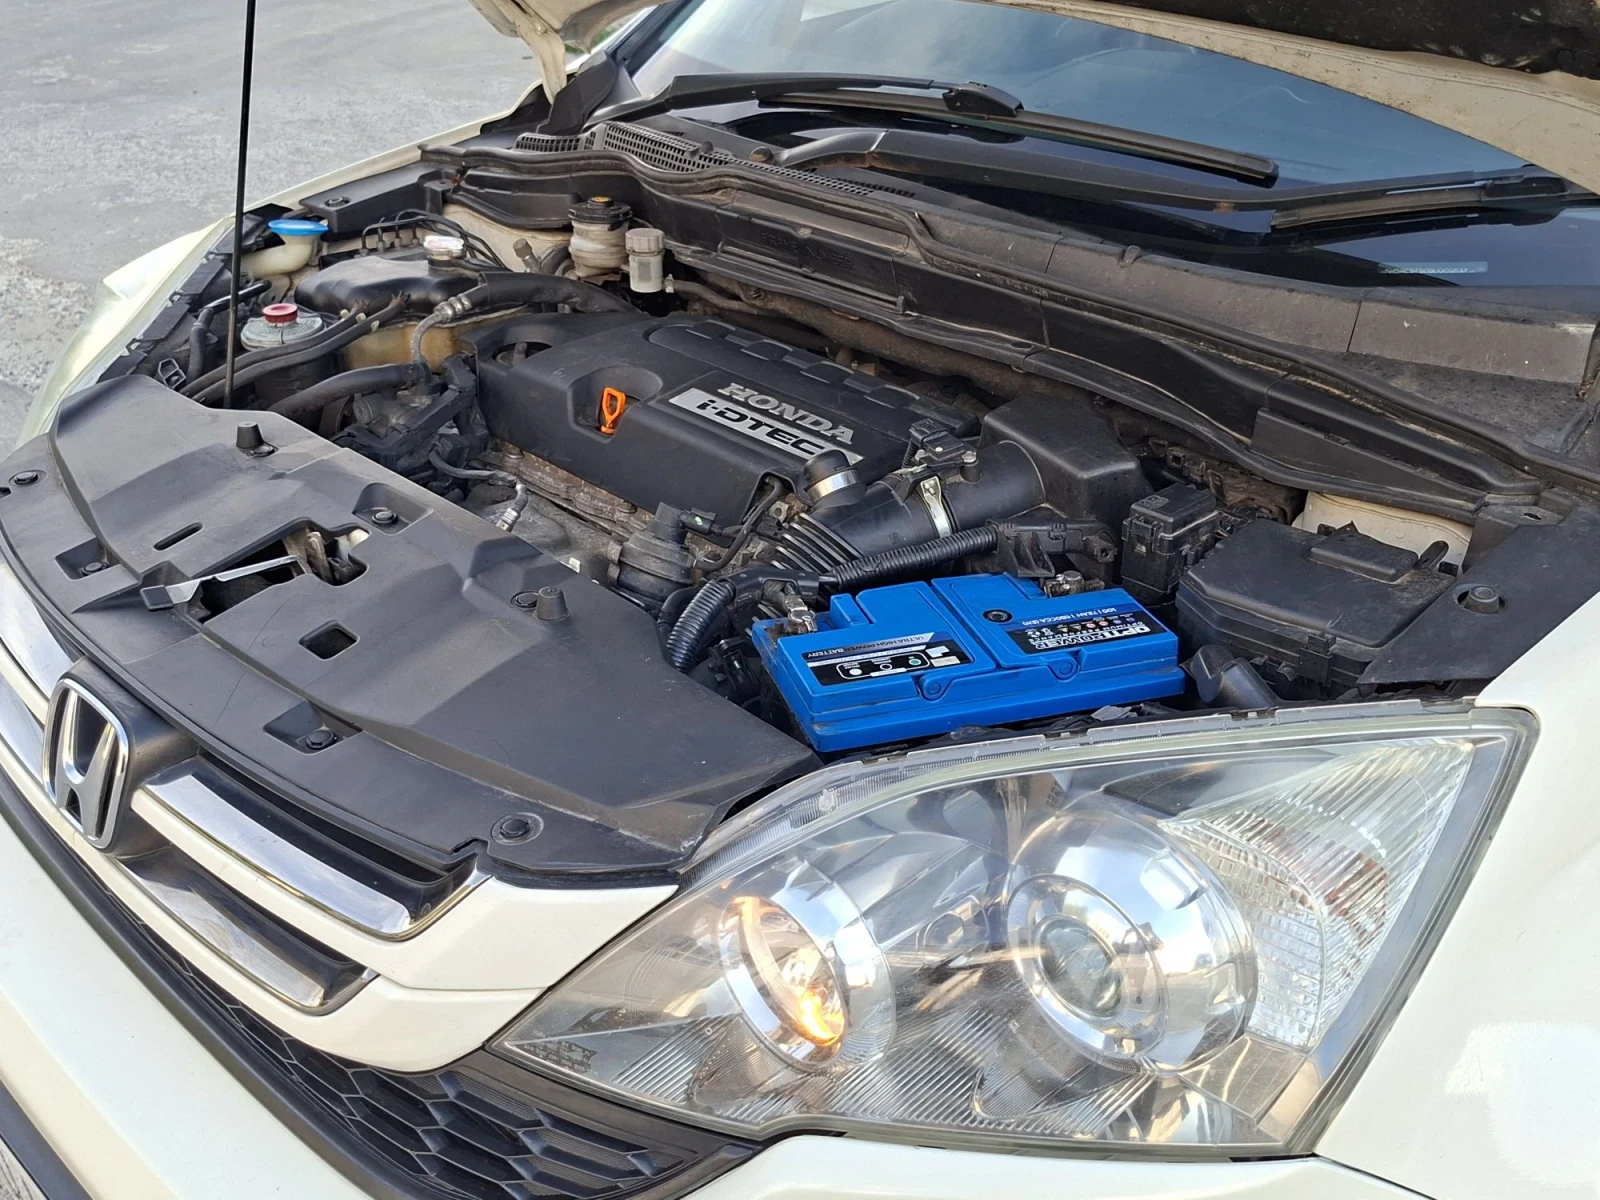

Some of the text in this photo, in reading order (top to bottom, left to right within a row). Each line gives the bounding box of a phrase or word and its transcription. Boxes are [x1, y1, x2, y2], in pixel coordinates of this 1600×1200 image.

[717, 382, 856, 445] HONDA
[877, 639, 897, 647] HIGH
[898, 636, 925, 645] ULTRA
[1035, 625, 1151, 650] OPTIPOWER
[807, 648, 845, 659] BATTERY
